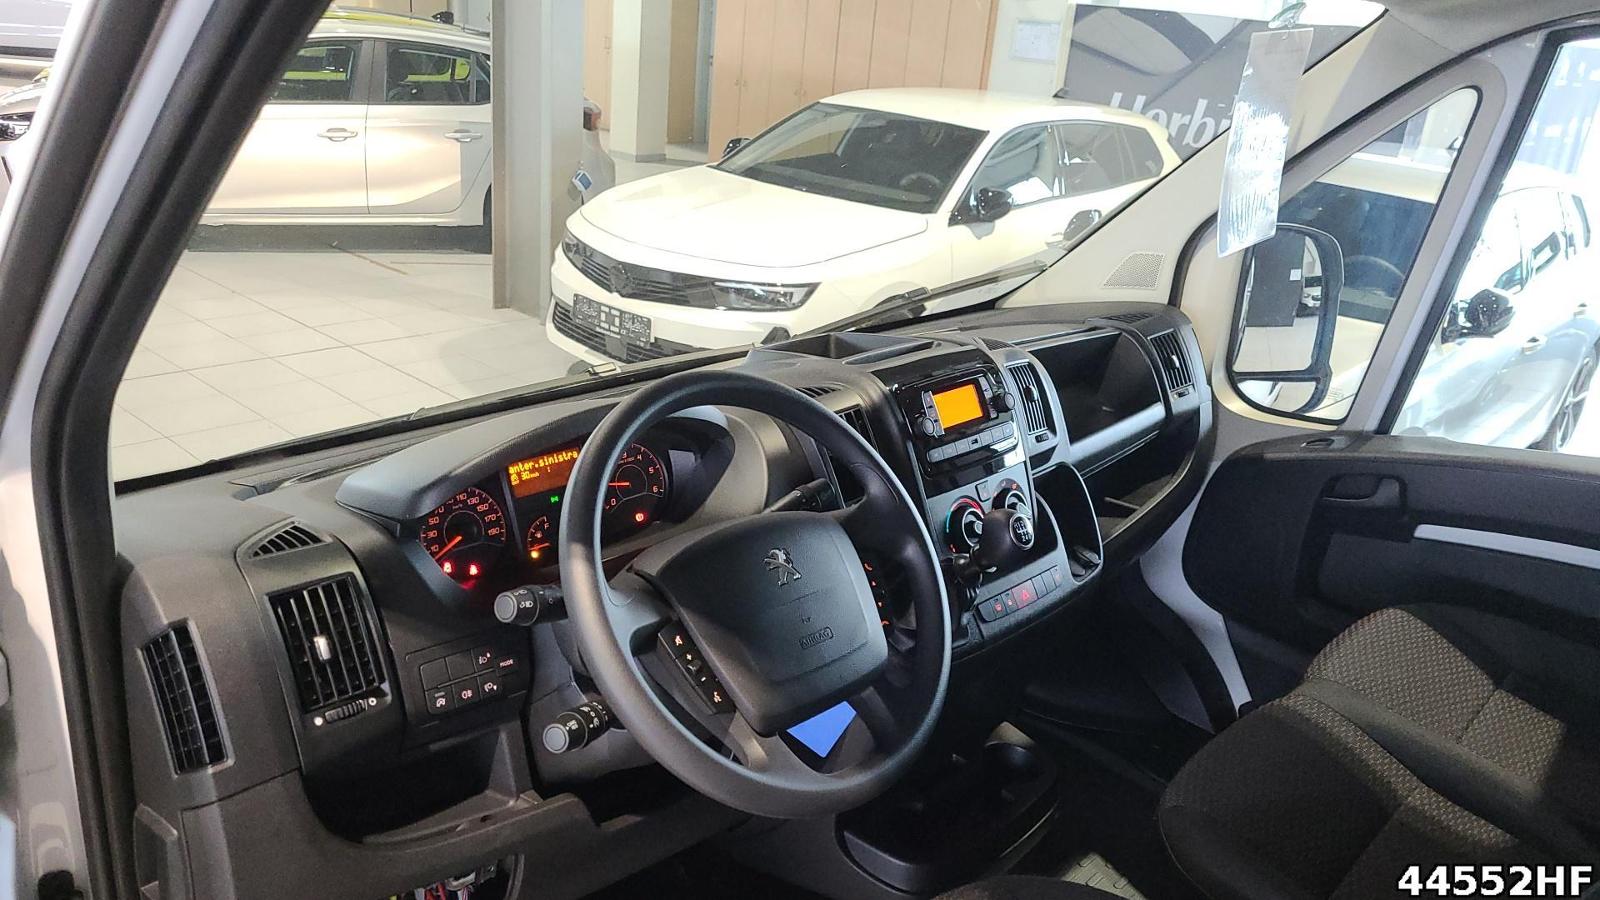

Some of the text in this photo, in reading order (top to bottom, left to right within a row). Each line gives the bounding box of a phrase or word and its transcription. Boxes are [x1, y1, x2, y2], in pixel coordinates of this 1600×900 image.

[467, 496, 480, 505] 130
[476, 503, 489, 512] 150
[428, 516, 439, 525] 50
[484, 513, 497, 523] 170
[427, 530, 438, 539] 30
[430, 544, 439, 552] 10
